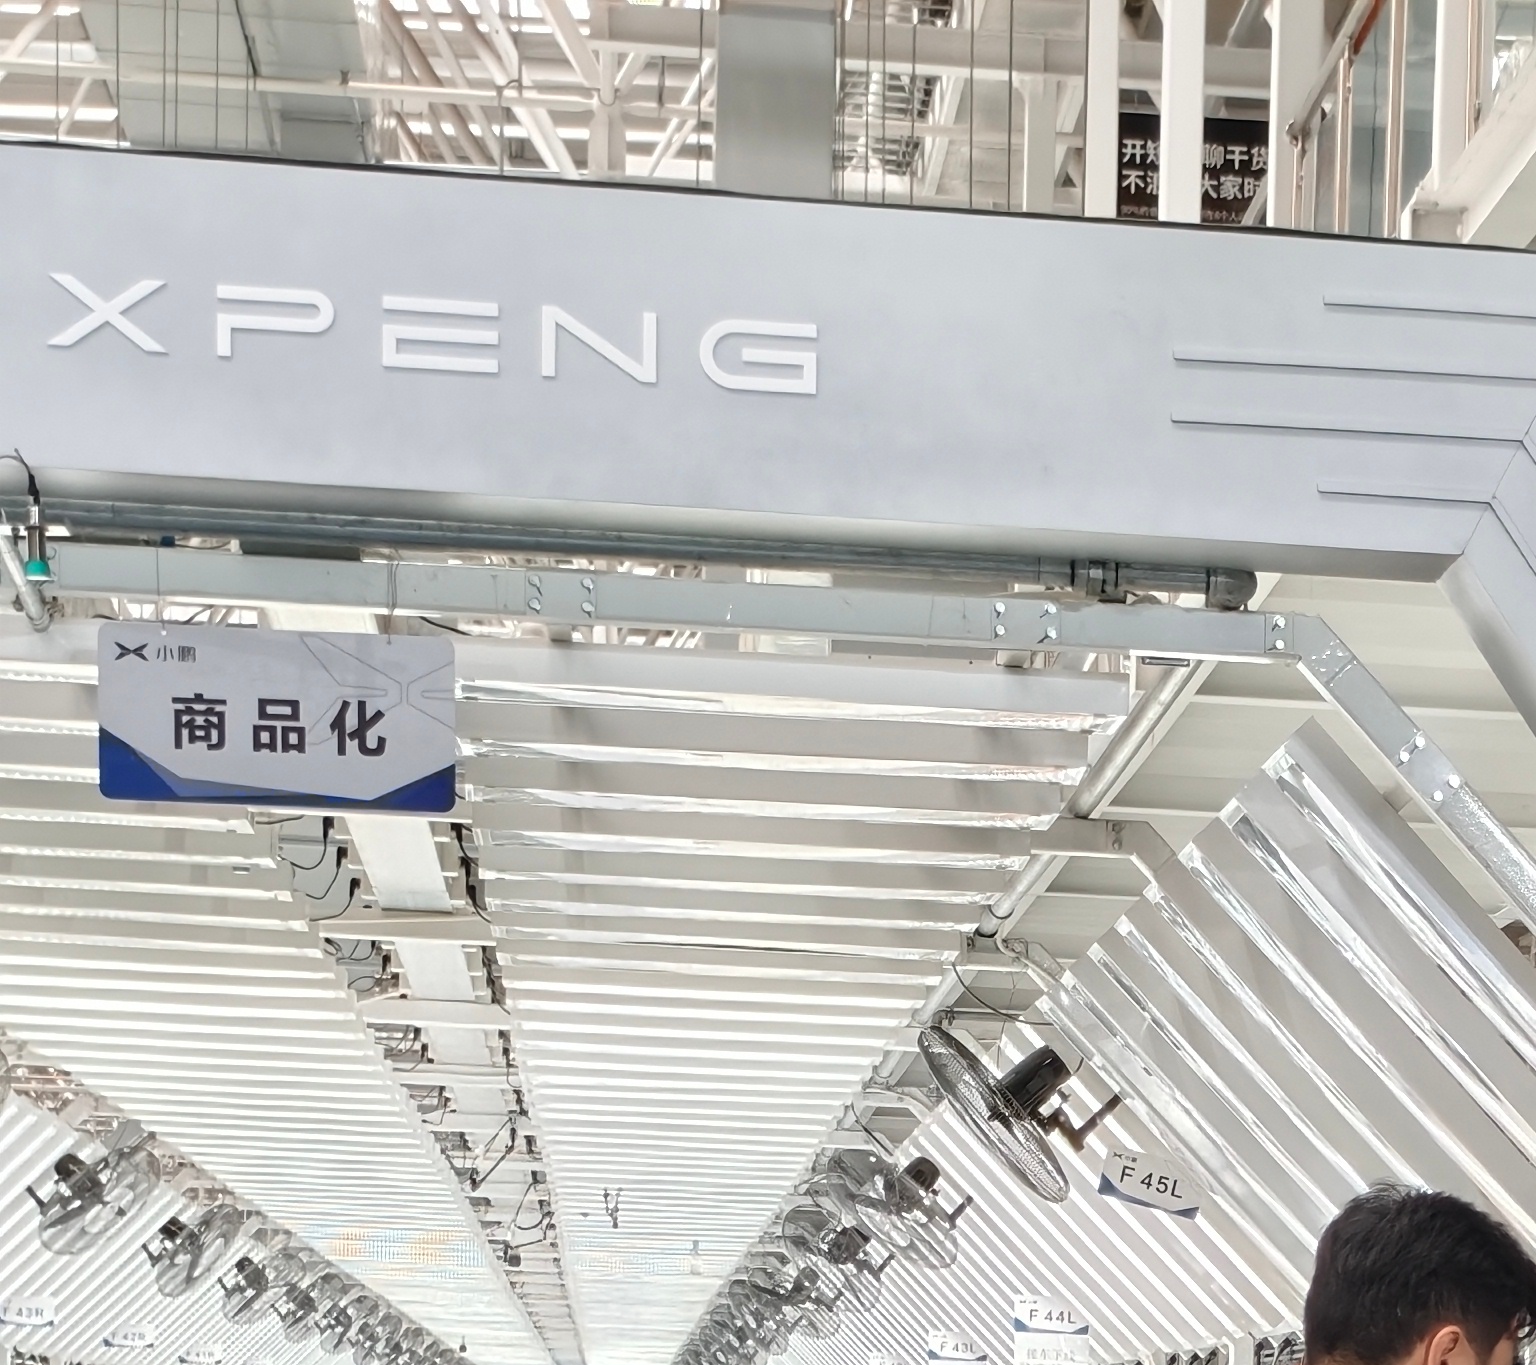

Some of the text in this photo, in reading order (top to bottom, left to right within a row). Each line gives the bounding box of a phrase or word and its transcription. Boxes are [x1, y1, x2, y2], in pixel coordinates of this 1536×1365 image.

[47, 272, 819, 396] XPENG
[156, 644, 197, 663] 小鹏
[171, 693, 387, 757] 商品化
[1119, 1165, 1183, 1199] F 45L
[1029, 1308, 1077, 1324] F 44L
